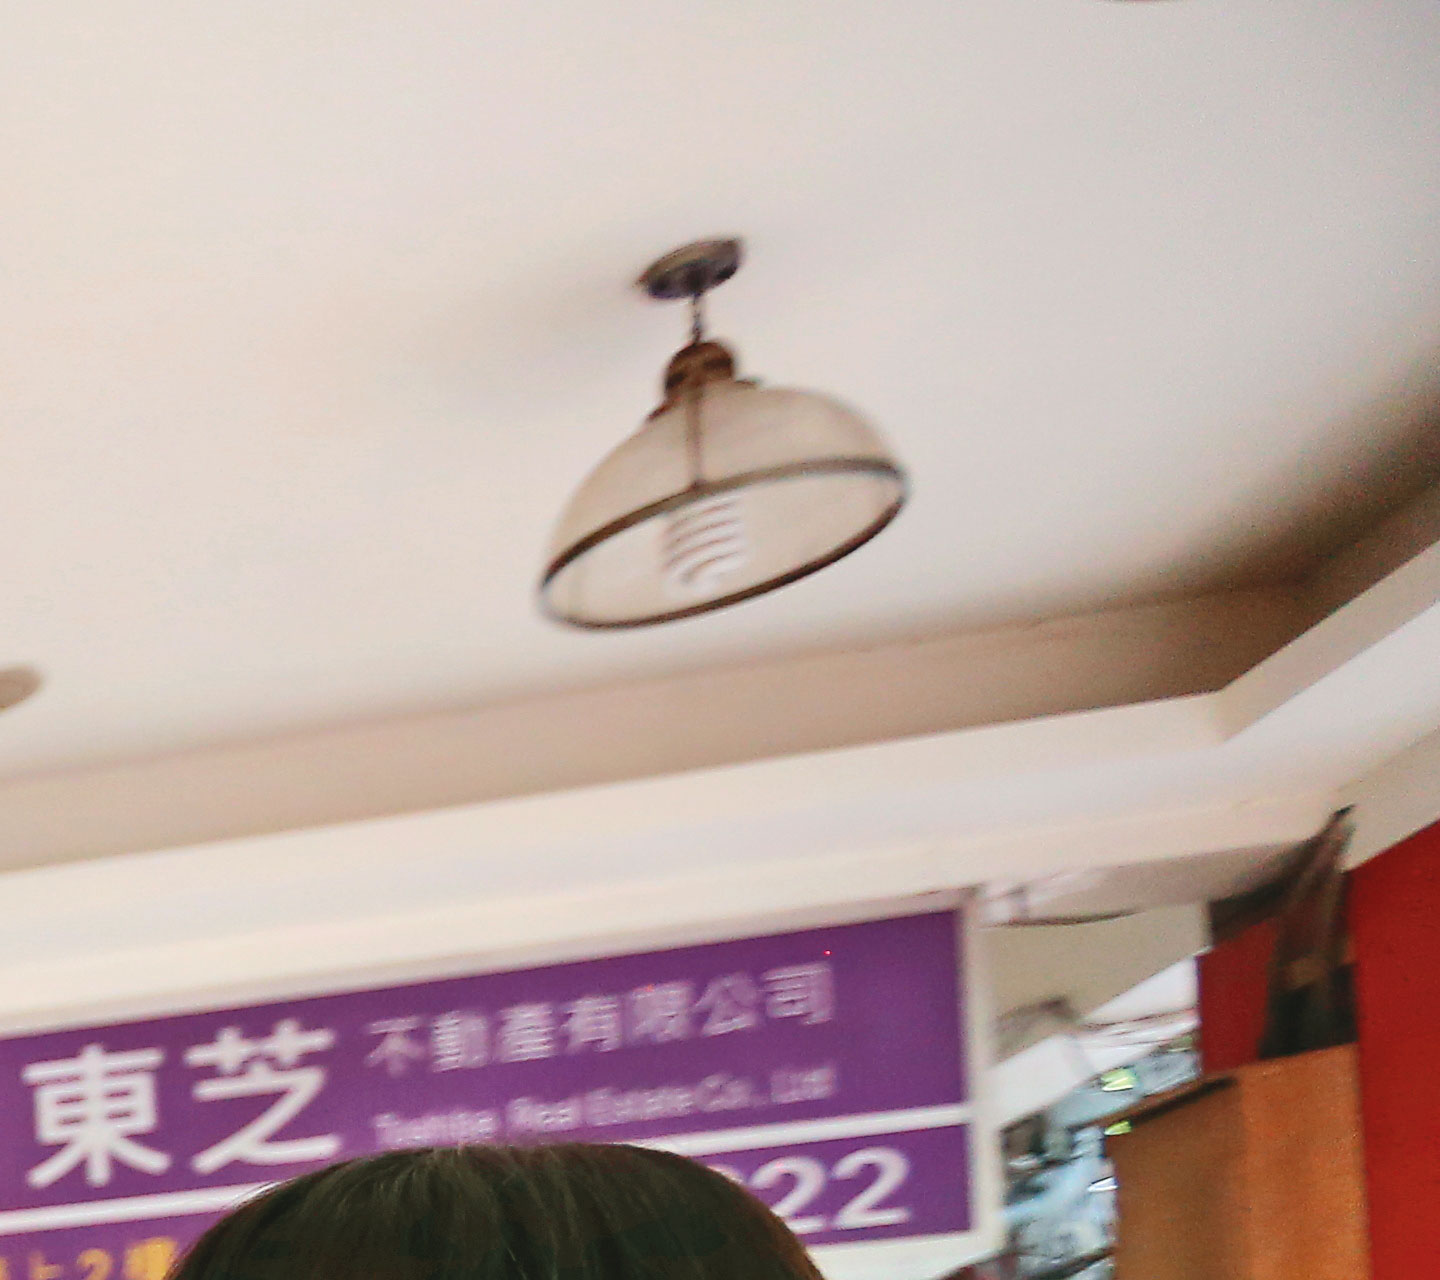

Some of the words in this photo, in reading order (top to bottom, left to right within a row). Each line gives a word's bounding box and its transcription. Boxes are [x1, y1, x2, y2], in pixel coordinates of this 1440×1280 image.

[362, 960, 835, 1078] 不動產有限公司
[19, 1018, 343, 1192] 東芝
